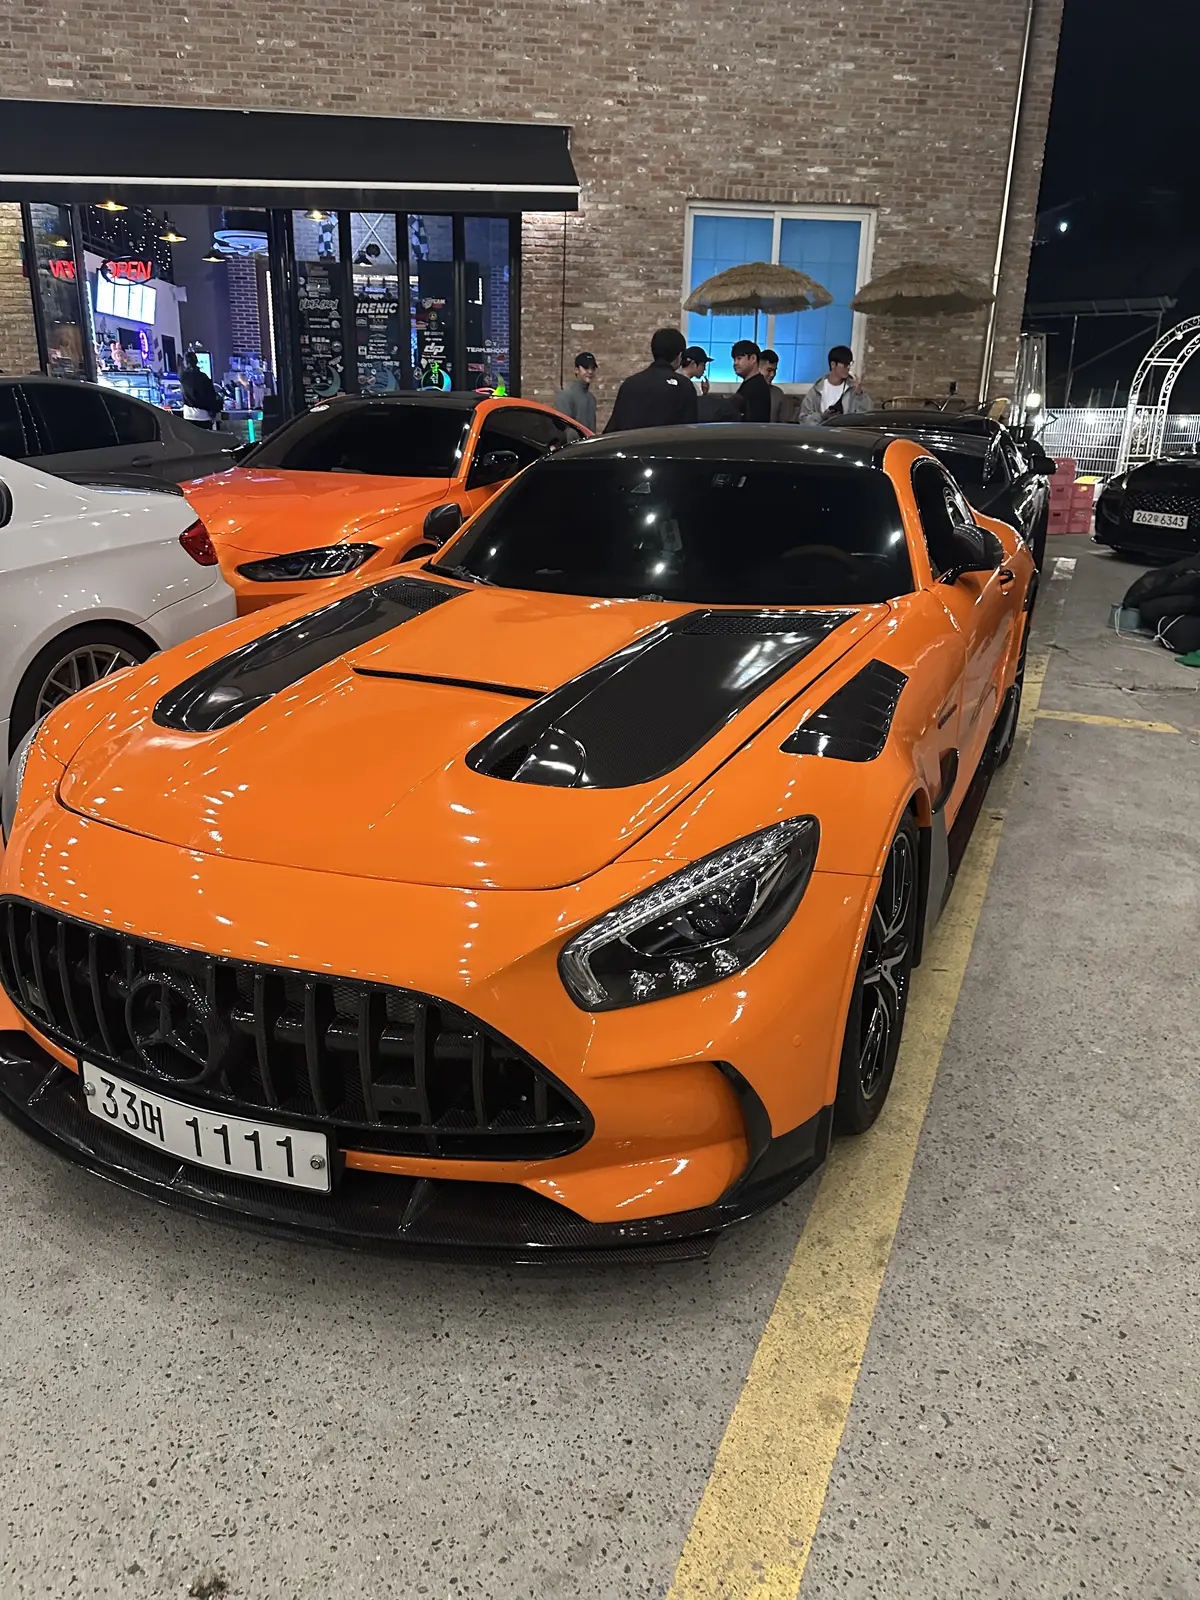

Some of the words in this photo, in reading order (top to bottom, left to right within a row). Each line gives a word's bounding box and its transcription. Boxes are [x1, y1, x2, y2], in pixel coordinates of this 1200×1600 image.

[106, 261, 152, 281] OPEN
[356, 302, 398, 314] IRENIC
[100, 1077, 164, 1142] 33머
[185, 1117, 294, 1177] 1111
